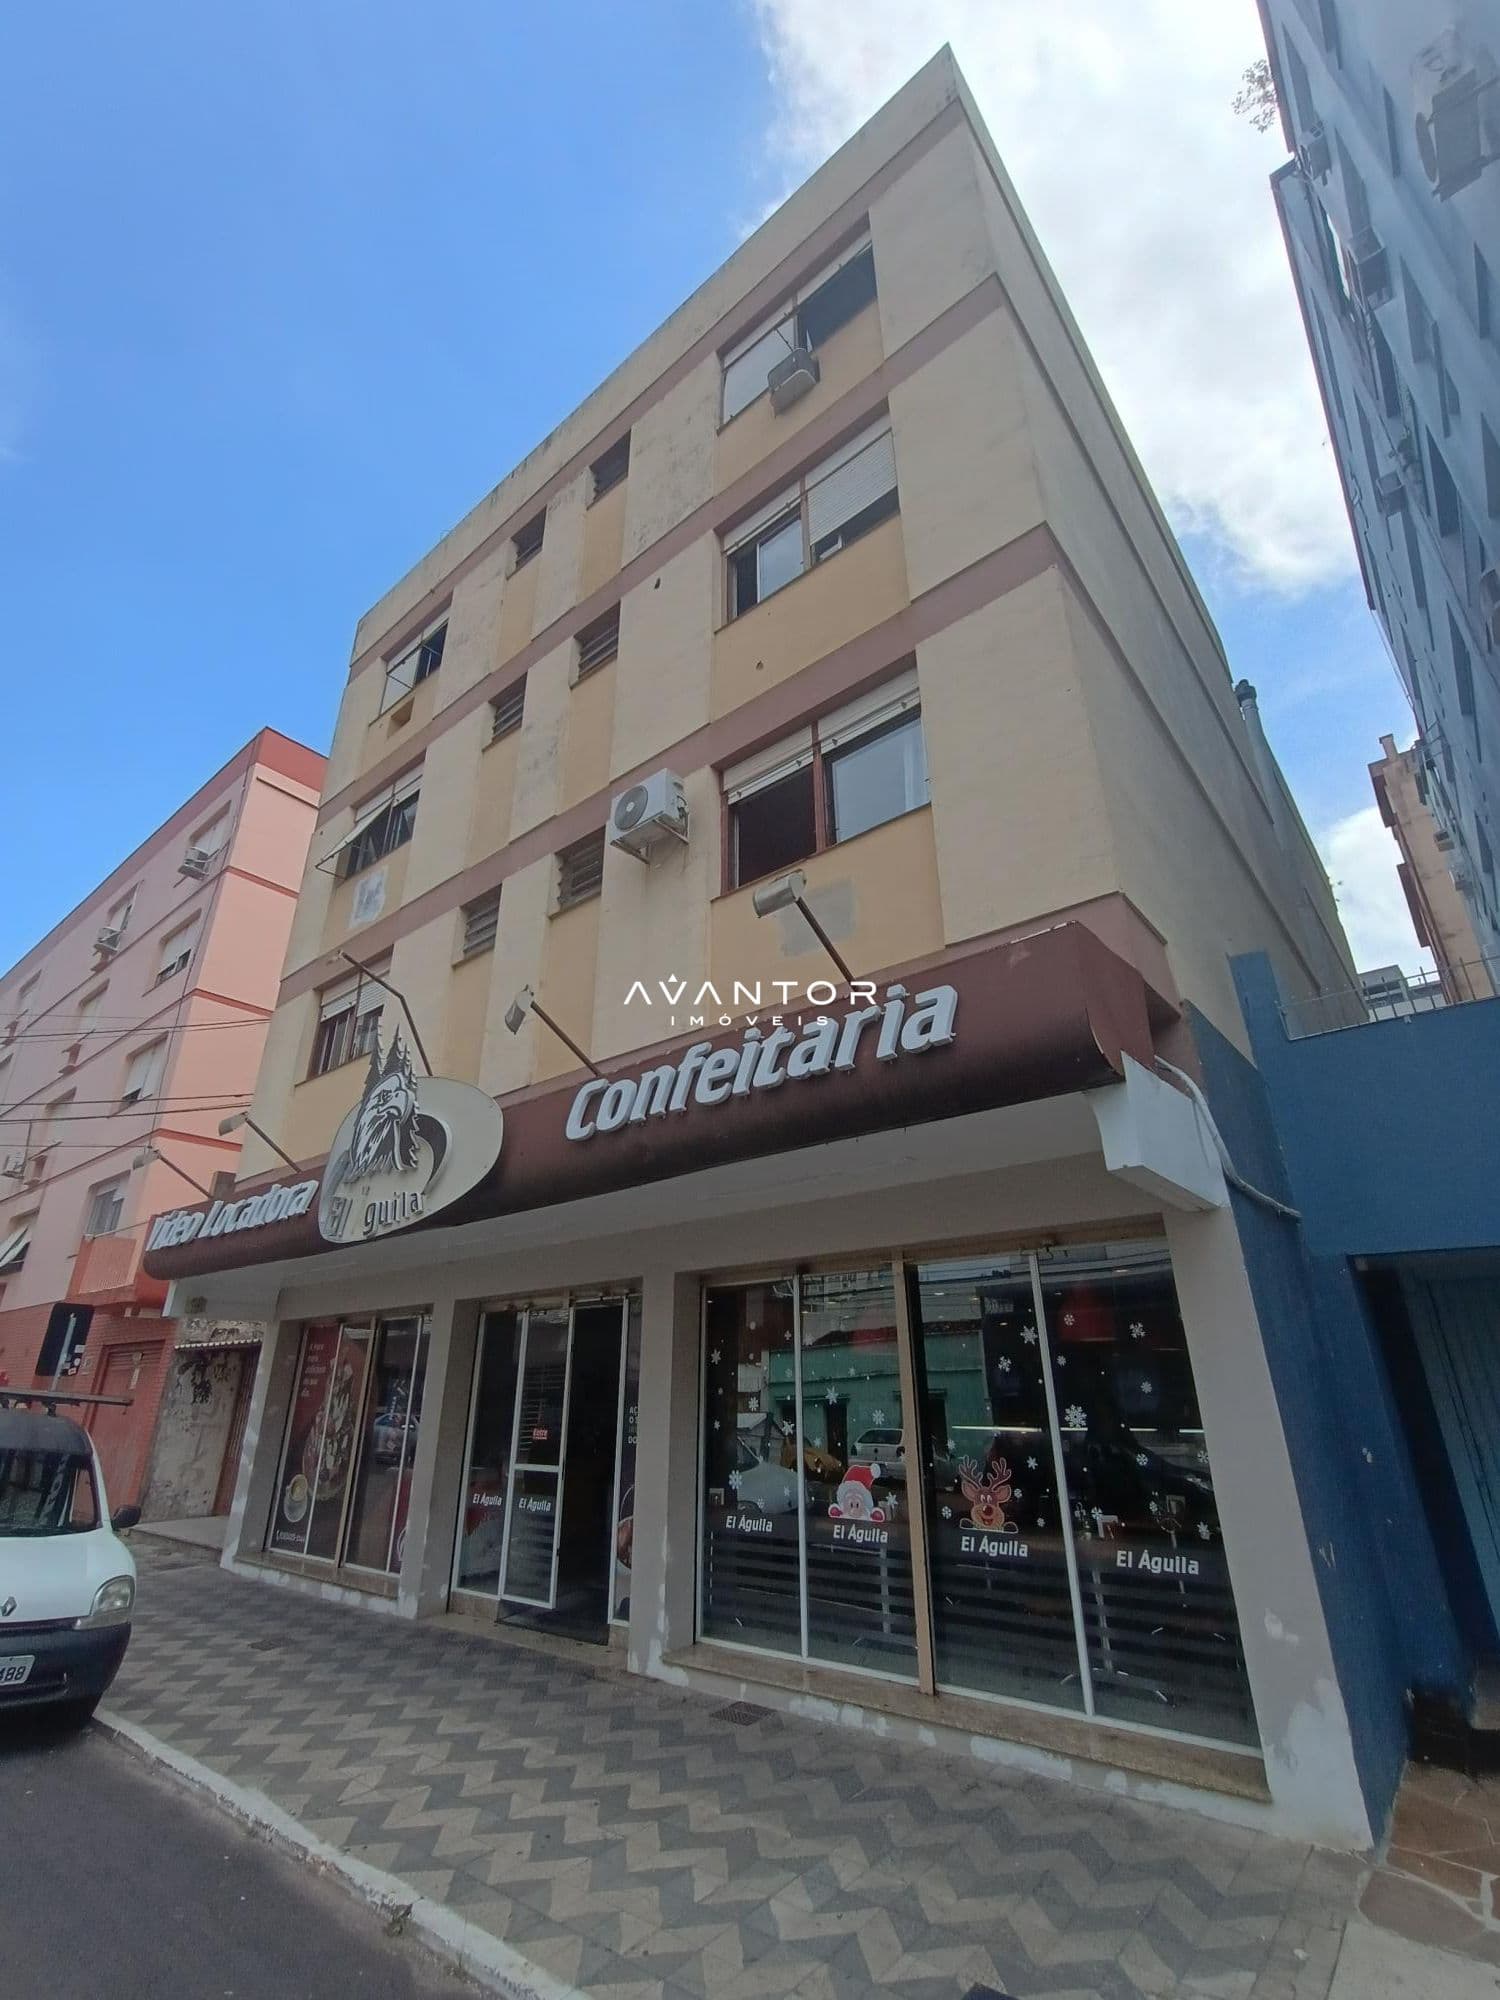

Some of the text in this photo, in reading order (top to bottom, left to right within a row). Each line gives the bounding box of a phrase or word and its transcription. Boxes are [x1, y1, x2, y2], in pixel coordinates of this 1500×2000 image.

[565, 984, 958, 1142] Confeitaria
[198, 1180, 319, 1239] Locadora
[356, 1186, 425, 1238] guila
[472, 1493, 481, 1504] El
[519, 1498, 527, 1509] El
[726, 1514, 773, 1532] El Águila
[833, 1524, 888, 1543] El Águila
[961, 1535, 1028, 1557] El Águila
[1116, 1550, 1200, 1575] El Águila
